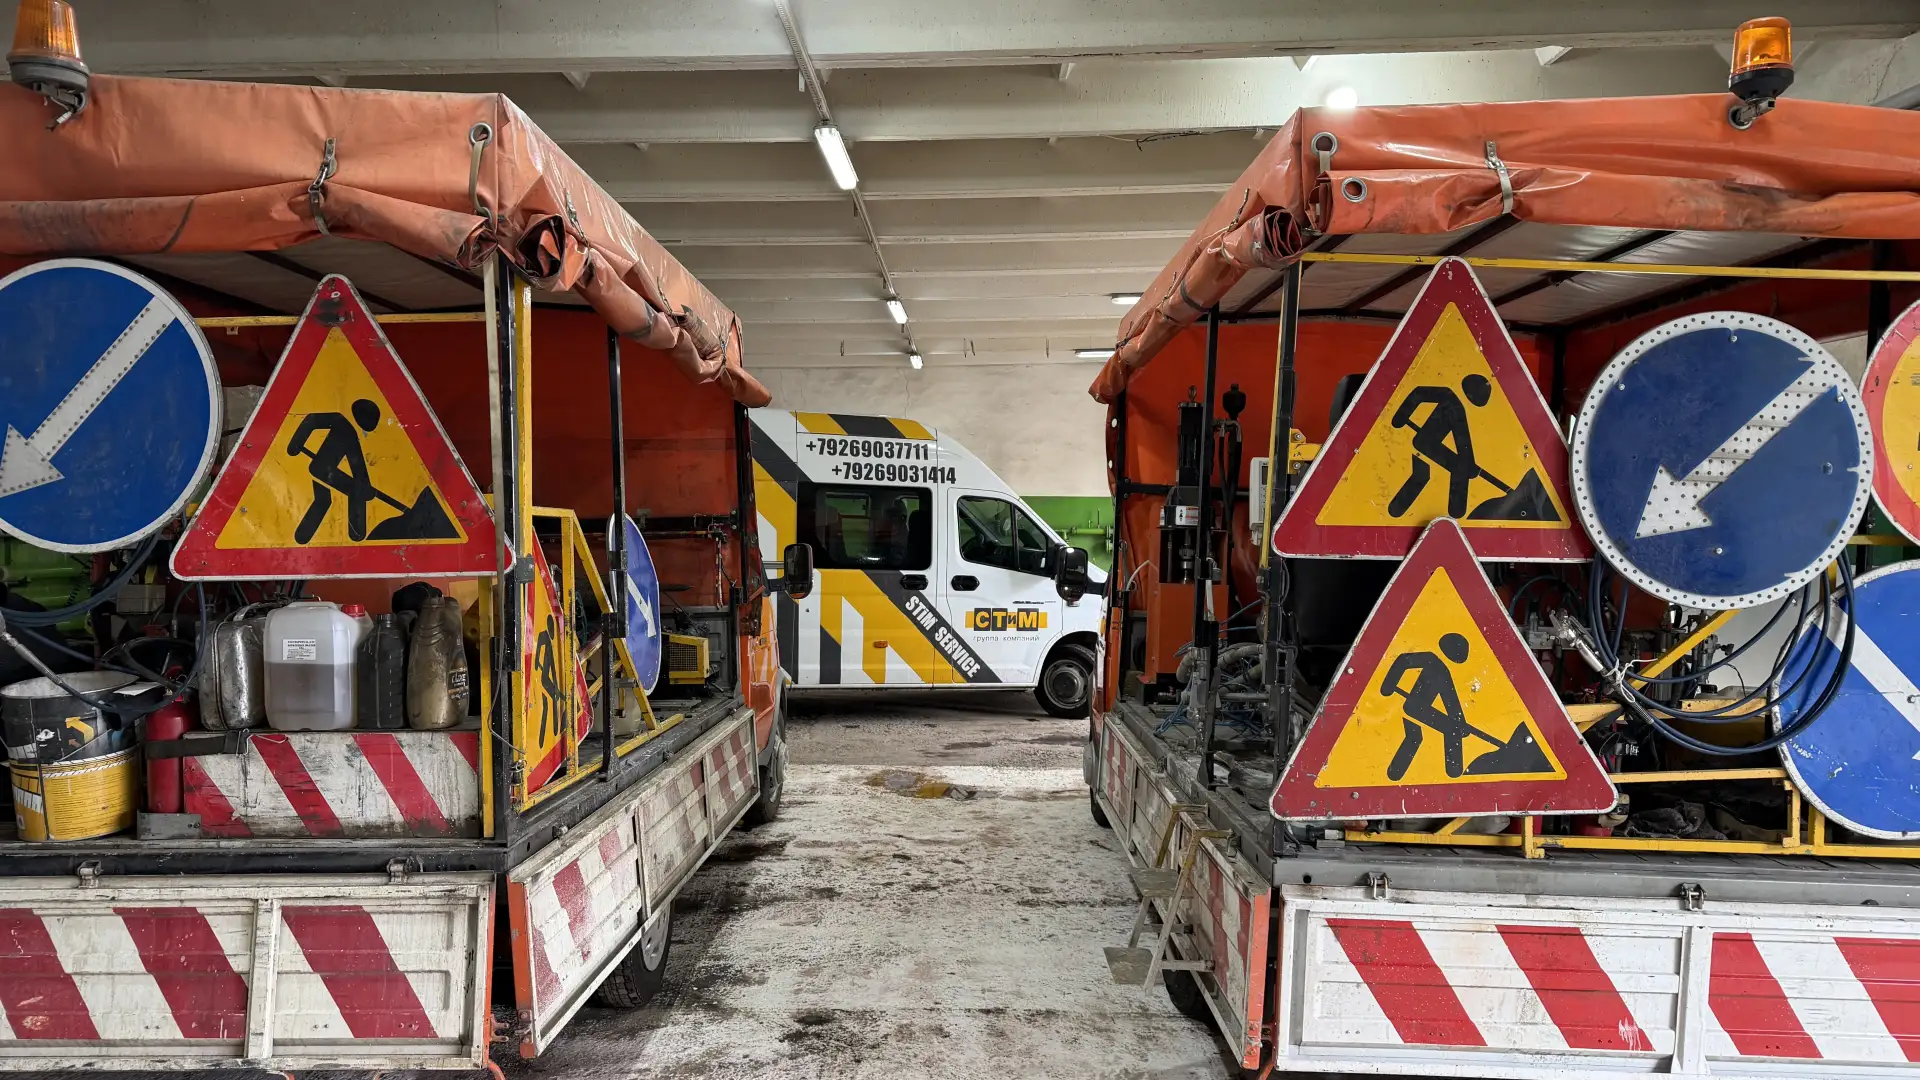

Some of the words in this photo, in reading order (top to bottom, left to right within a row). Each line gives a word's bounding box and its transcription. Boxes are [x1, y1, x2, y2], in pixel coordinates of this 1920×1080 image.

[806, 438, 929, 460] +79269037711
[832, 462, 957, 484] +79269031414
[973, 635, 999, 643] группа
[1002, 634, 1040, 642] компаний
[934, 626, 981, 678] SERVICE
